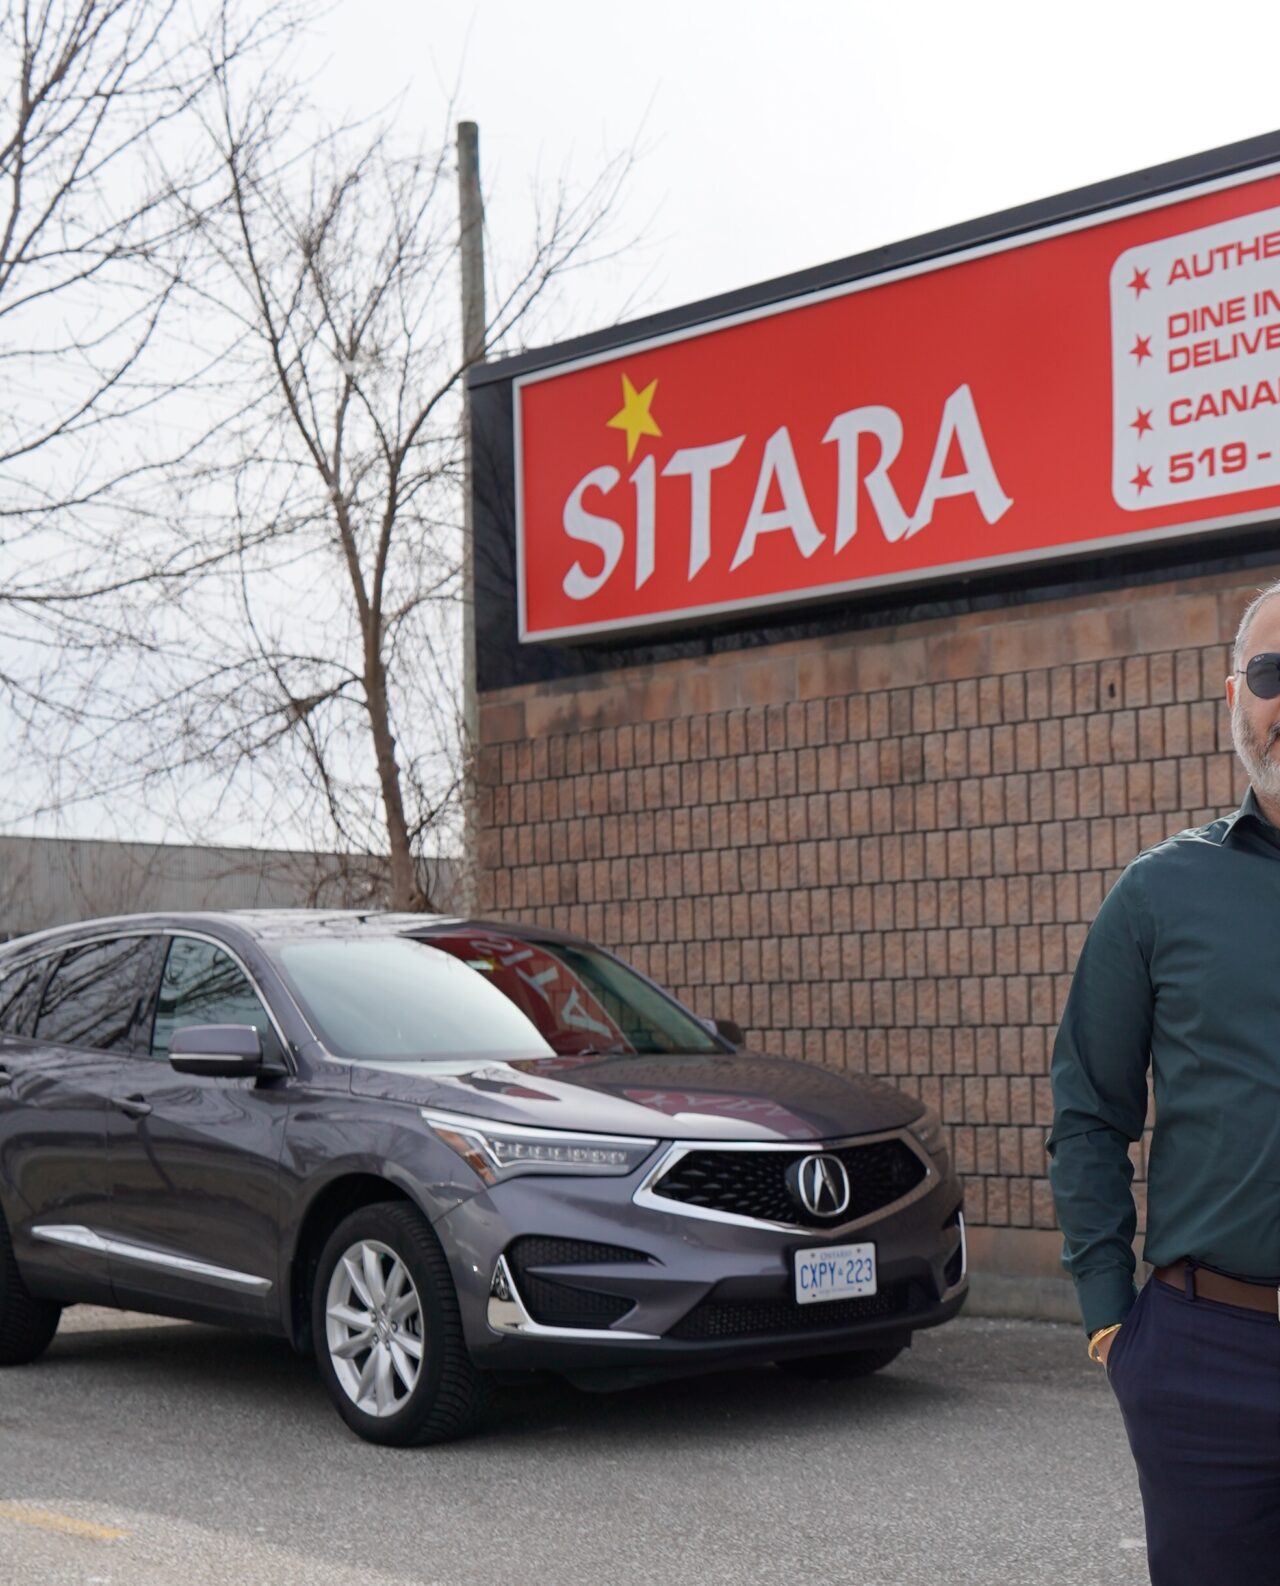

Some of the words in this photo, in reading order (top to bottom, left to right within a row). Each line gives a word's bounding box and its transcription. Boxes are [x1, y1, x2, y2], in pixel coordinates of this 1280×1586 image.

[1167, 296, 1246, 339] DINE
[562, 383, 1014, 600] SITARA
[800, 1260, 837, 1289] CXPY
[846, 1257, 873, 1284] 223
